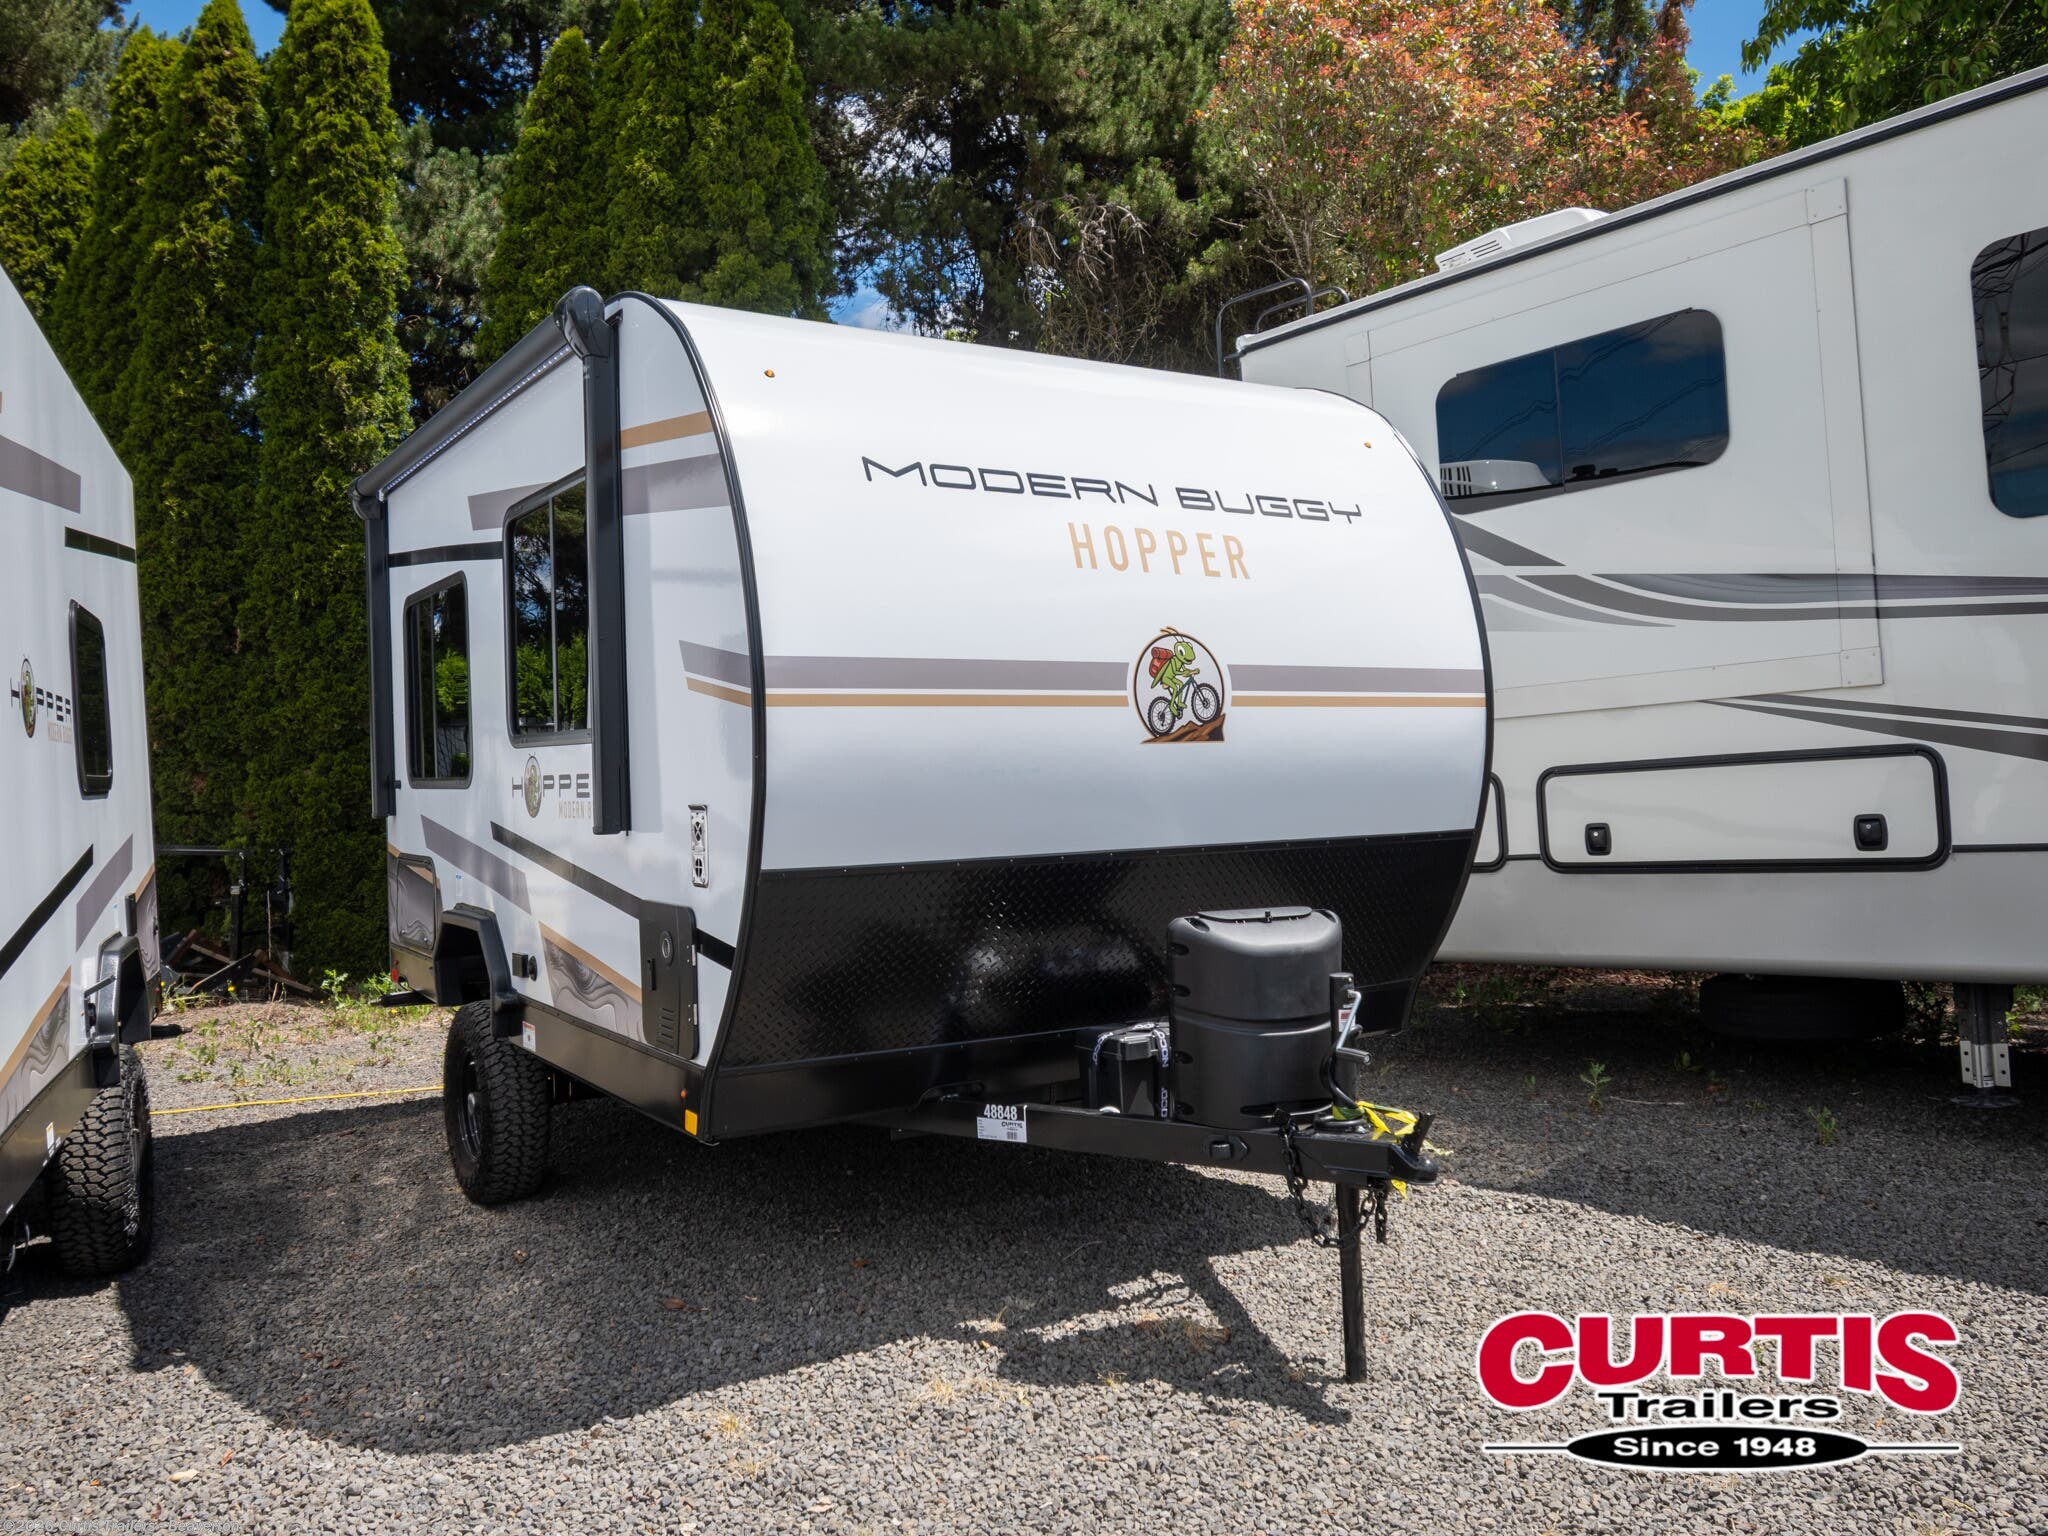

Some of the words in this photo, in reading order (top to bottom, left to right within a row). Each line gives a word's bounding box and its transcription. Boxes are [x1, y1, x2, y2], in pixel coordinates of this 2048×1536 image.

[861, 455, 1160, 507] MODERN
[1175, 486, 1363, 524] BUGGY
[1066, 521, 1251, 580] HOPPER
[559, 800, 585, 819] MODERN
[983, 1103, 1018, 1120] 48848
[1160, 1088, 1168, 1118] OCO
